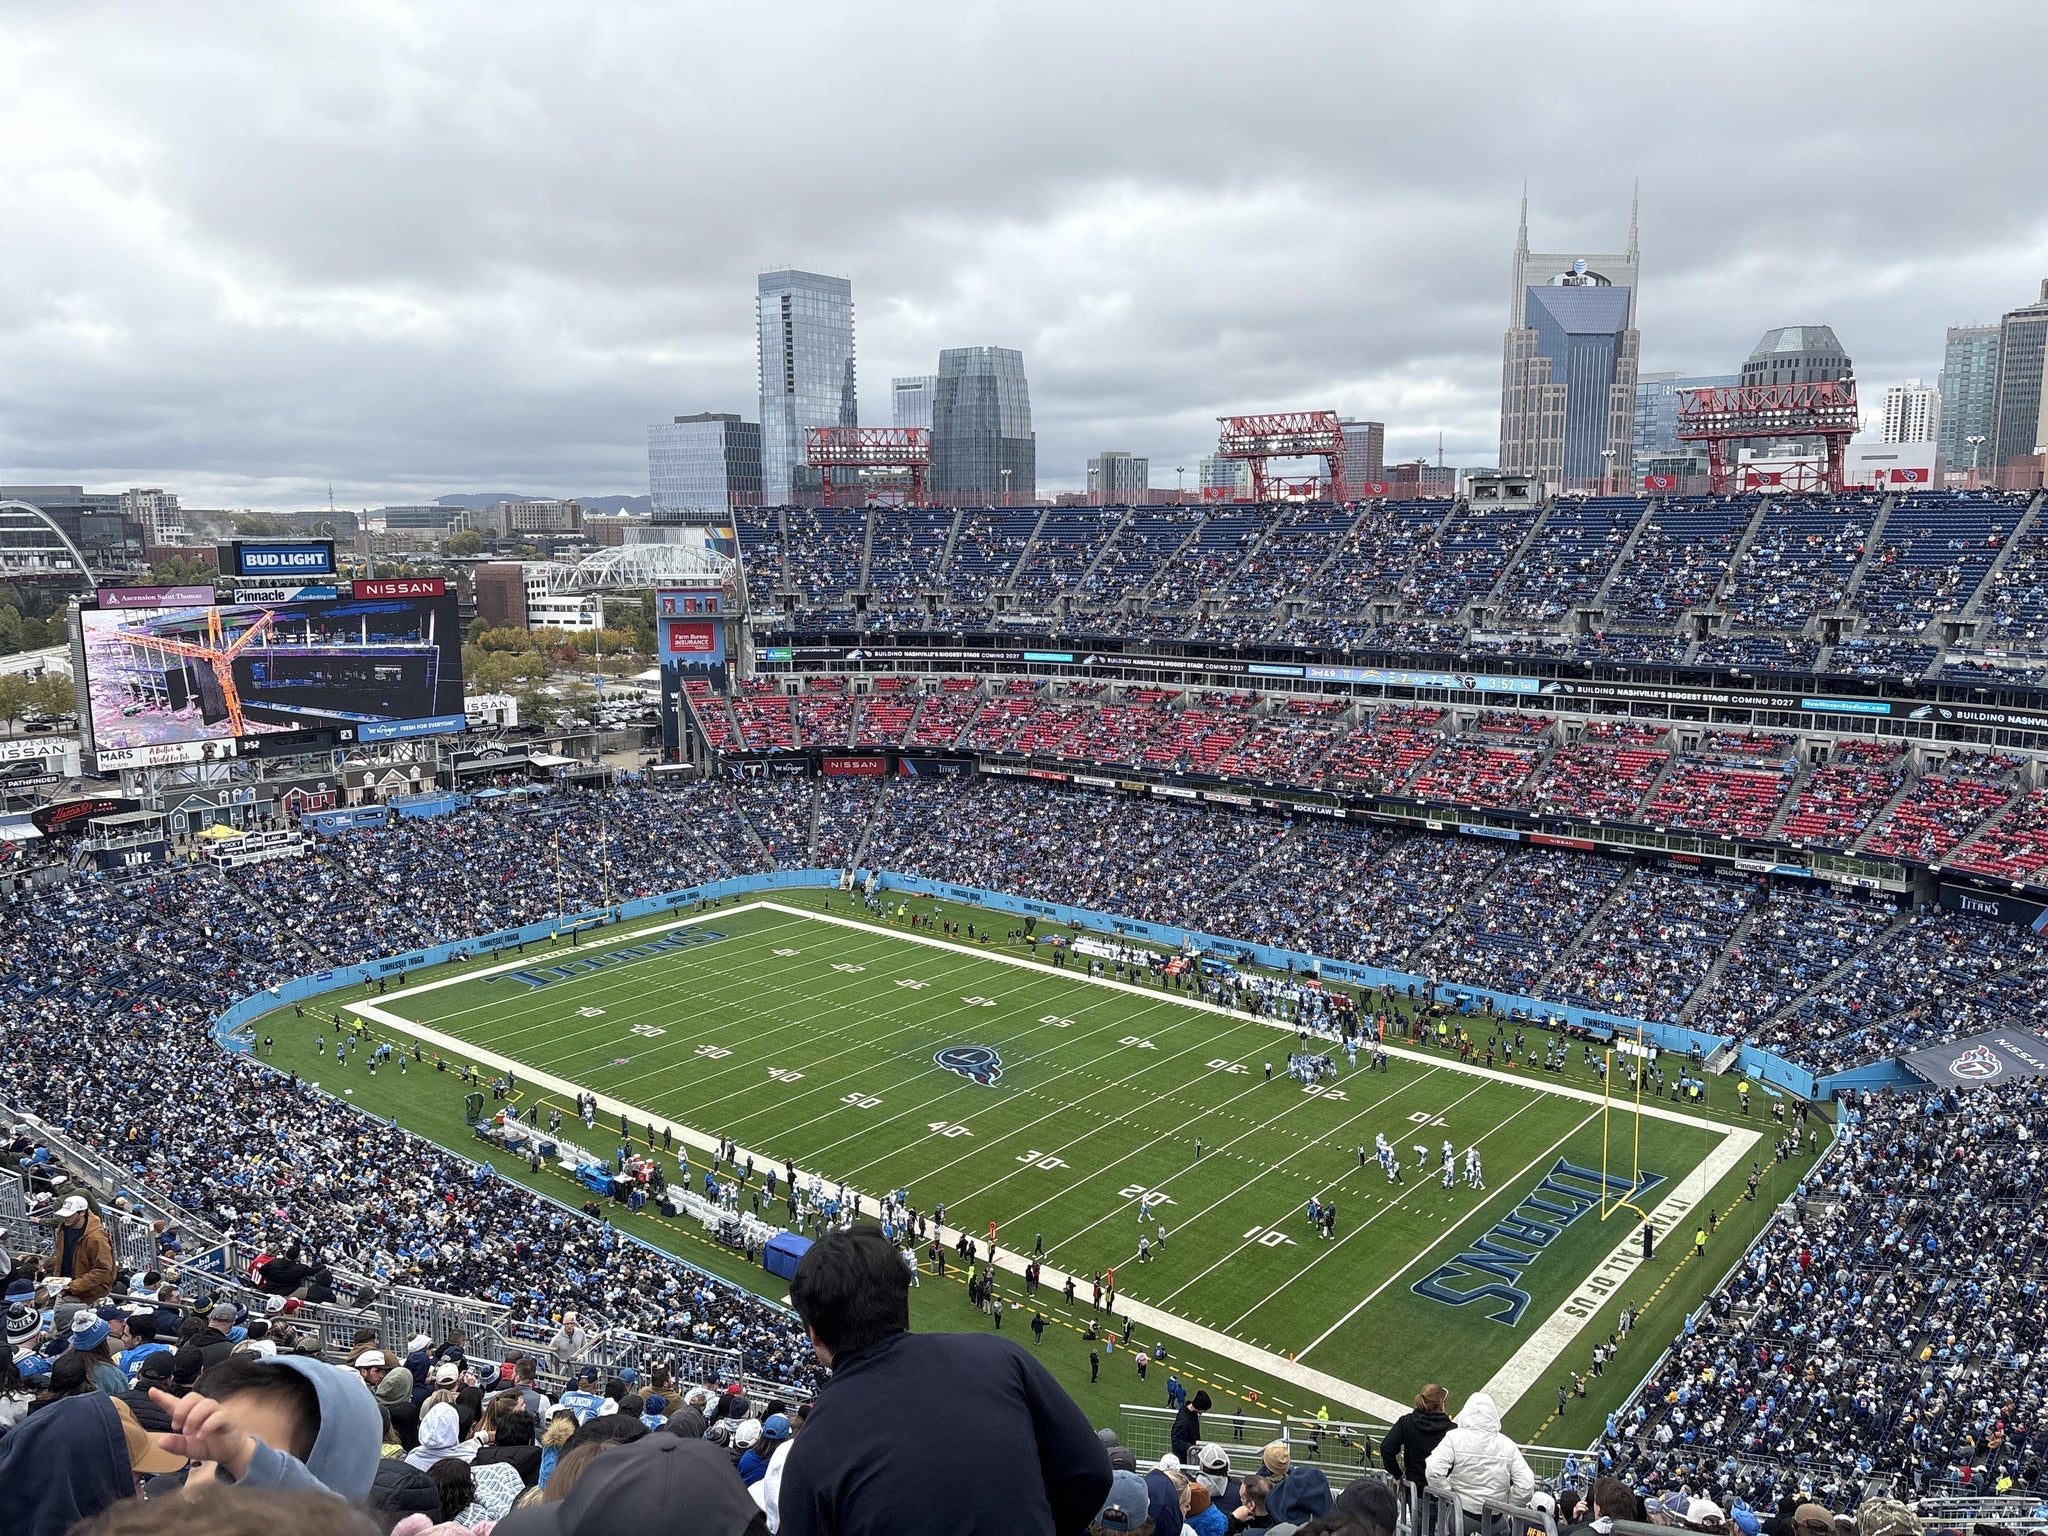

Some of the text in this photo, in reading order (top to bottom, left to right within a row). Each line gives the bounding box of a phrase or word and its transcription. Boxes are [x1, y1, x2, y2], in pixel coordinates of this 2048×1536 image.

[246, 553, 325, 567] BUD LIGHT
[366, 583, 433, 595] NISSAN
[121, 593, 202, 602] Ascension Saint Thomas
[236, 589, 285, 602] Pinnacle
[1107, 657, 1131, 665] BUILDING
[1133, 658, 1164, 667] NASHVILLE'S
[1165, 661, 1186, 669] BIGGEST
[1205, 663, 1228, 671] COMING
[1229, 664, 1244, 672] 2027
[1311, 669, 1324, 677] 3rd
[1401, 673, 1409, 682] 7
[1430, 675, 1438, 684] 7
[1489, 678, 1514, 690] 3:52
[1520, 681, 1532, 689] 1st
[1577, 686, 1794, 706] BUILDING NASHVILLE'S BIGGEST STAGE COMING 2027
[1804, 700, 1887, 711] NewNissanStadium.com
[1956, 711, 2006, 723] BUILDING
[428, 720, 457, 728] EVERYONE
[376, 724, 397, 737] Kroger
[473, 741, 487, 757] JACK
[100, 750, 134, 762] MARS
[101, 761, 129, 771] Petcare
[782, 763, 804, 775] Kroger
[831, 761, 877, 769] NISSAN
[8, 776, 58, 788] PATHFINDER
[1263, 800, 1280, 809] FedEx
[1293, 804, 1332, 816] ROCKY LAW
[267, 833, 280, 842] LAW
[1478, 829, 1511, 840] Gallagher
[1671, 854, 1701, 863] verizon
[1667, 862, 1699, 872] JOHNSON
[1736, 861, 1766, 871] Pinnacle
[1715, 868, 1749, 878] HOLOVAK
[951, 888, 969, 898] TENNESSEE
[1831, 884, 1853, 894] REESE
[666, 894, 686, 904] TENNESSEE
[1960, 895, 2000, 916] TITANS
[1113, 920, 1148, 934] TENNESSEE TOUGH
[479, 932, 519, 949] TENNESSEE TOUGH
[1211, 941, 1235, 951] TENNESSEE
[380, 955, 425, 972] TENNESSEE TOUGH
[481, 926, 728, 990] TITANS
[833, 963, 866, 974] 20
[1321, 963, 1348, 976] TENNESSEE
[898, 978, 931, 990] 30
[963, 996, 998, 1007] 40
[576, 1007, 606, 1018] 10
[1038, 1014, 1076, 1028] 50
[1582, 1017, 1615, 1031] TENNESSEE
[630, 1024, 667, 1038] 20
[1118, 1035, 1154, 1049] 40
[694, 1044, 734, 1059] 30
[1994, 1039, 2048, 1070] NISSAN
[1205, 1058, 1248, 1074] 30
[770, 1067, 805, 1082] 40
[1905, 1062, 1928, 1083] NISSAN
[1301, 1084, 1347, 1100] 20
[840, 1092, 884, 1109] 50
[1406, 1111, 1445, 1127] 10
[927, 1121, 969, 1138] 40
[1015, 1150, 1063, 1170] 30
[1118, 1183, 1171, 1207] 20
[1243, 1225, 1289, 1247] 10
[1410, 1156, 1669, 1328] TITANS
[1564, 1198, 1693, 1319] IT TAKES ALL OF US
[564, 1396, 593, 1406] TOMLINSON
